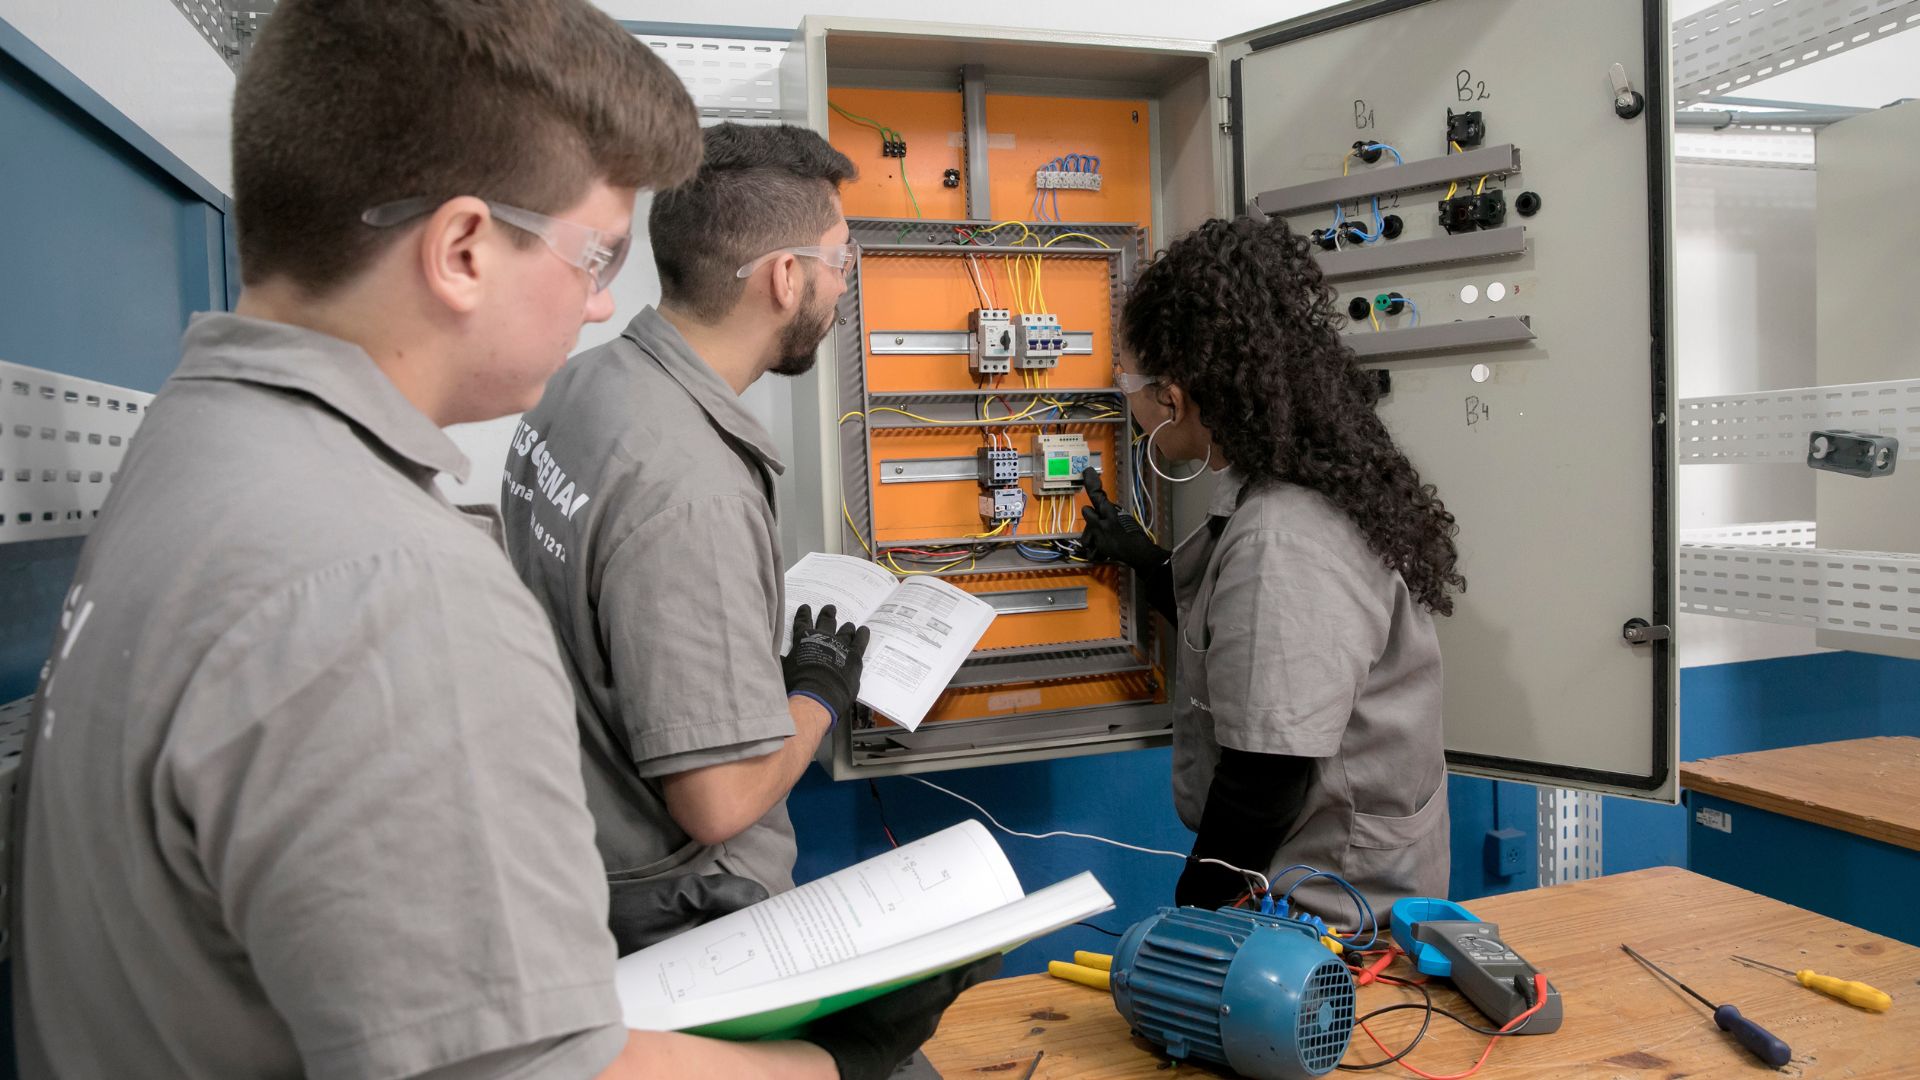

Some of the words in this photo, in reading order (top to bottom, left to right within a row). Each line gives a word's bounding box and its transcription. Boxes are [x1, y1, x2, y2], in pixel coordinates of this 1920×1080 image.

[1456, 69, 1490, 101] B2
[1354, 99, 1375, 129] B1
[1377, 193, 1400, 211] L2
[1465, 395, 1490, 426] B4
